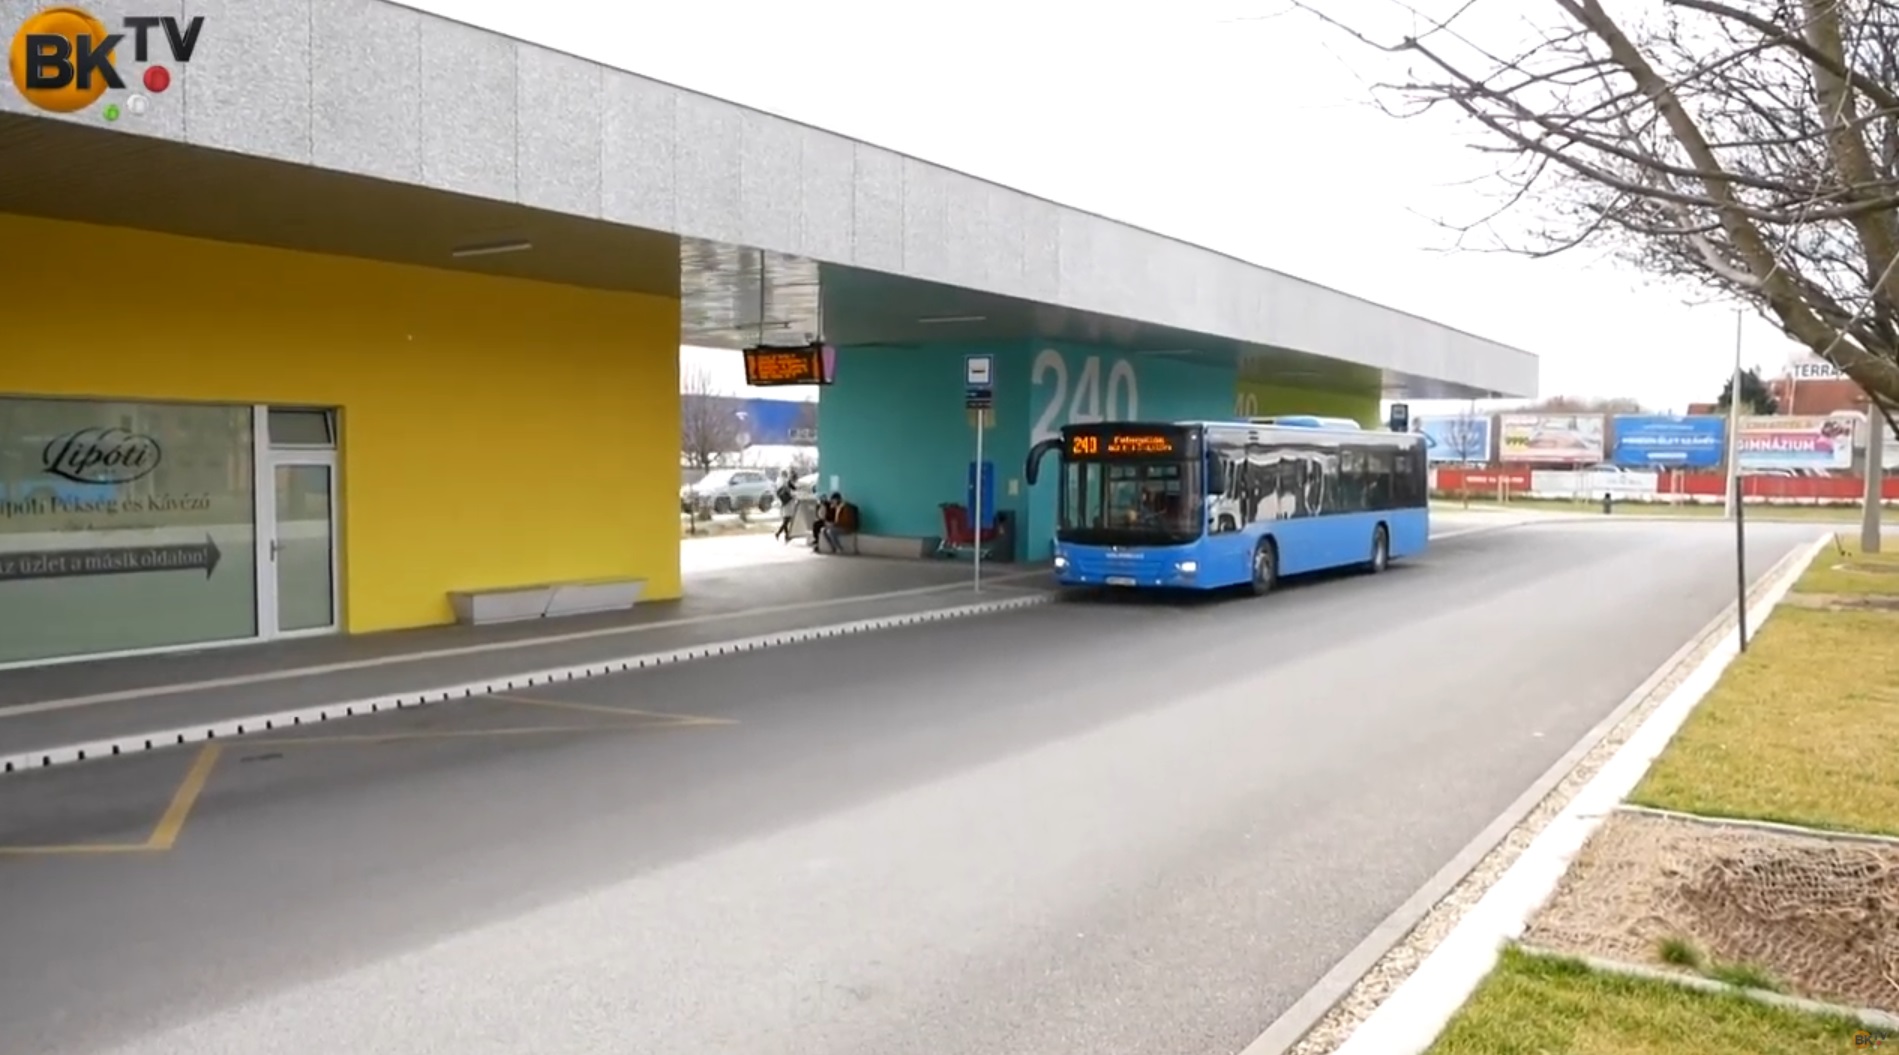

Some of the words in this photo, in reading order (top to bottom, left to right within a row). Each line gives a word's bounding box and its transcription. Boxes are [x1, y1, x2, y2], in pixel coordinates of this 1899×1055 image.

[1794, 363, 1842, 377] TERRA
[1031, 349, 1138, 447] 240
[1073, 436, 1097, 453] 240
[43, 431, 156, 482] Lipóti
[51, 495, 118, 515] Pékség
[123, 495, 143, 511] és
[148, 493, 211, 512] Kávézó
[20, 555, 66, 574] üzlet
[71, 560, 81, 570] a
[85, 554, 140, 570] másik
